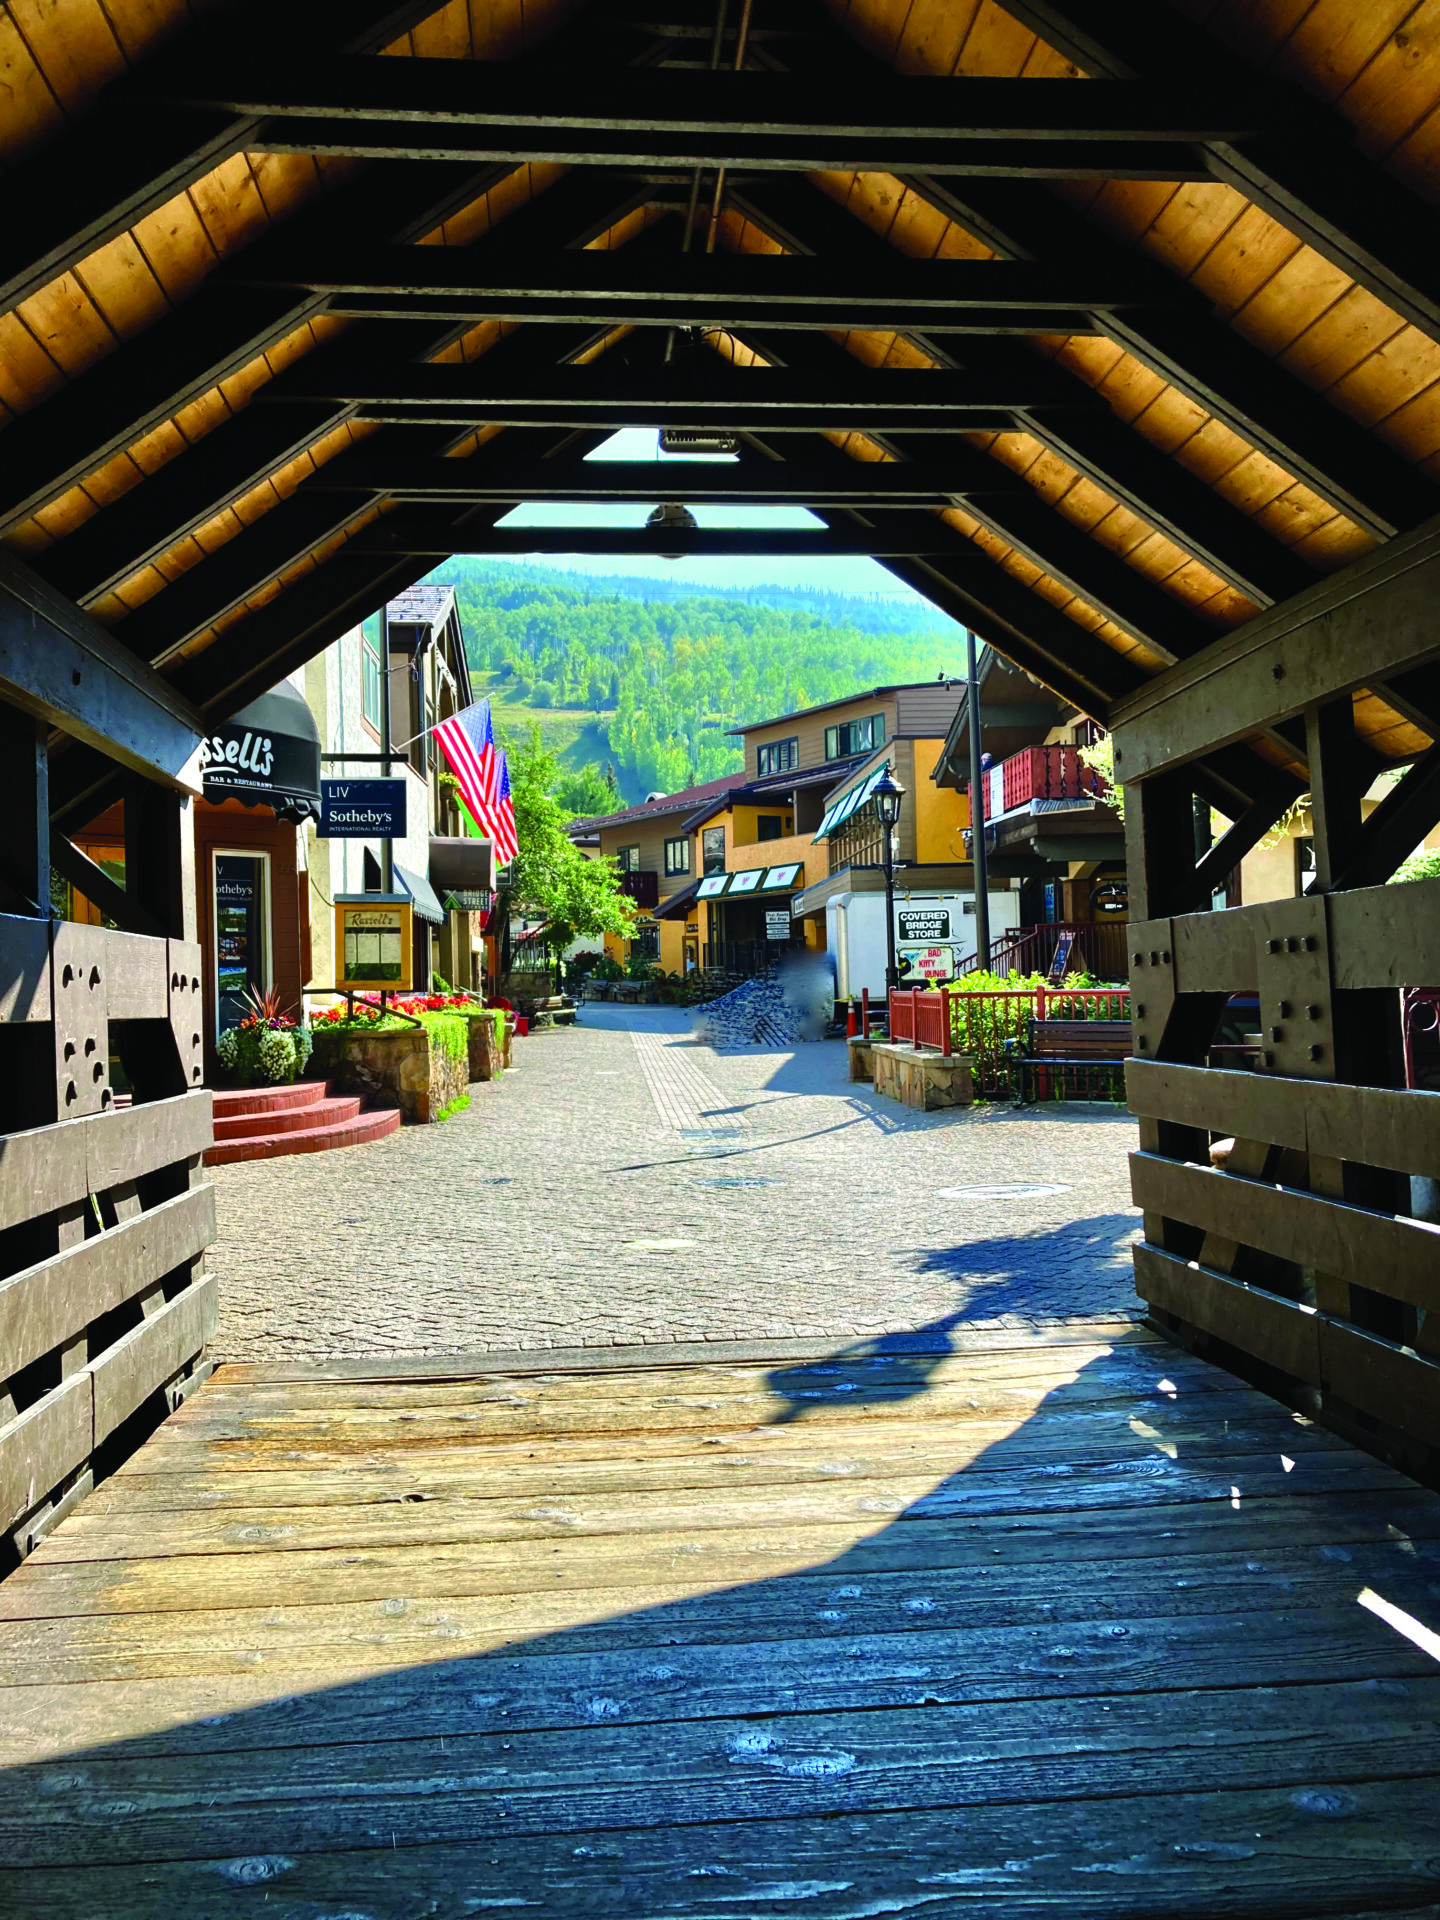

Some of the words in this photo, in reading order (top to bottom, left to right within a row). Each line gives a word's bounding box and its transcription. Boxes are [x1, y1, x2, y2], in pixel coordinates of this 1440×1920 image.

[201, 732, 274, 776] ssell's
[233, 778, 273, 789] RESTAURANT
[328, 786, 350, 798] LIV
[329, 809, 392, 825] Sotheby's
[216, 883, 253, 897] otheby's
[463, 889, 489, 897] BRIDGE
[463, 897, 489, 905] STREET
[900, 911, 948, 921] COVERED
[905, 921, 943, 930] BRIDGE
[907, 930, 942, 939] STORE
[928, 948, 941, 957] BAD
[919, 959, 936, 968] KITTY
[924, 969, 947, 979] LOUNGE
